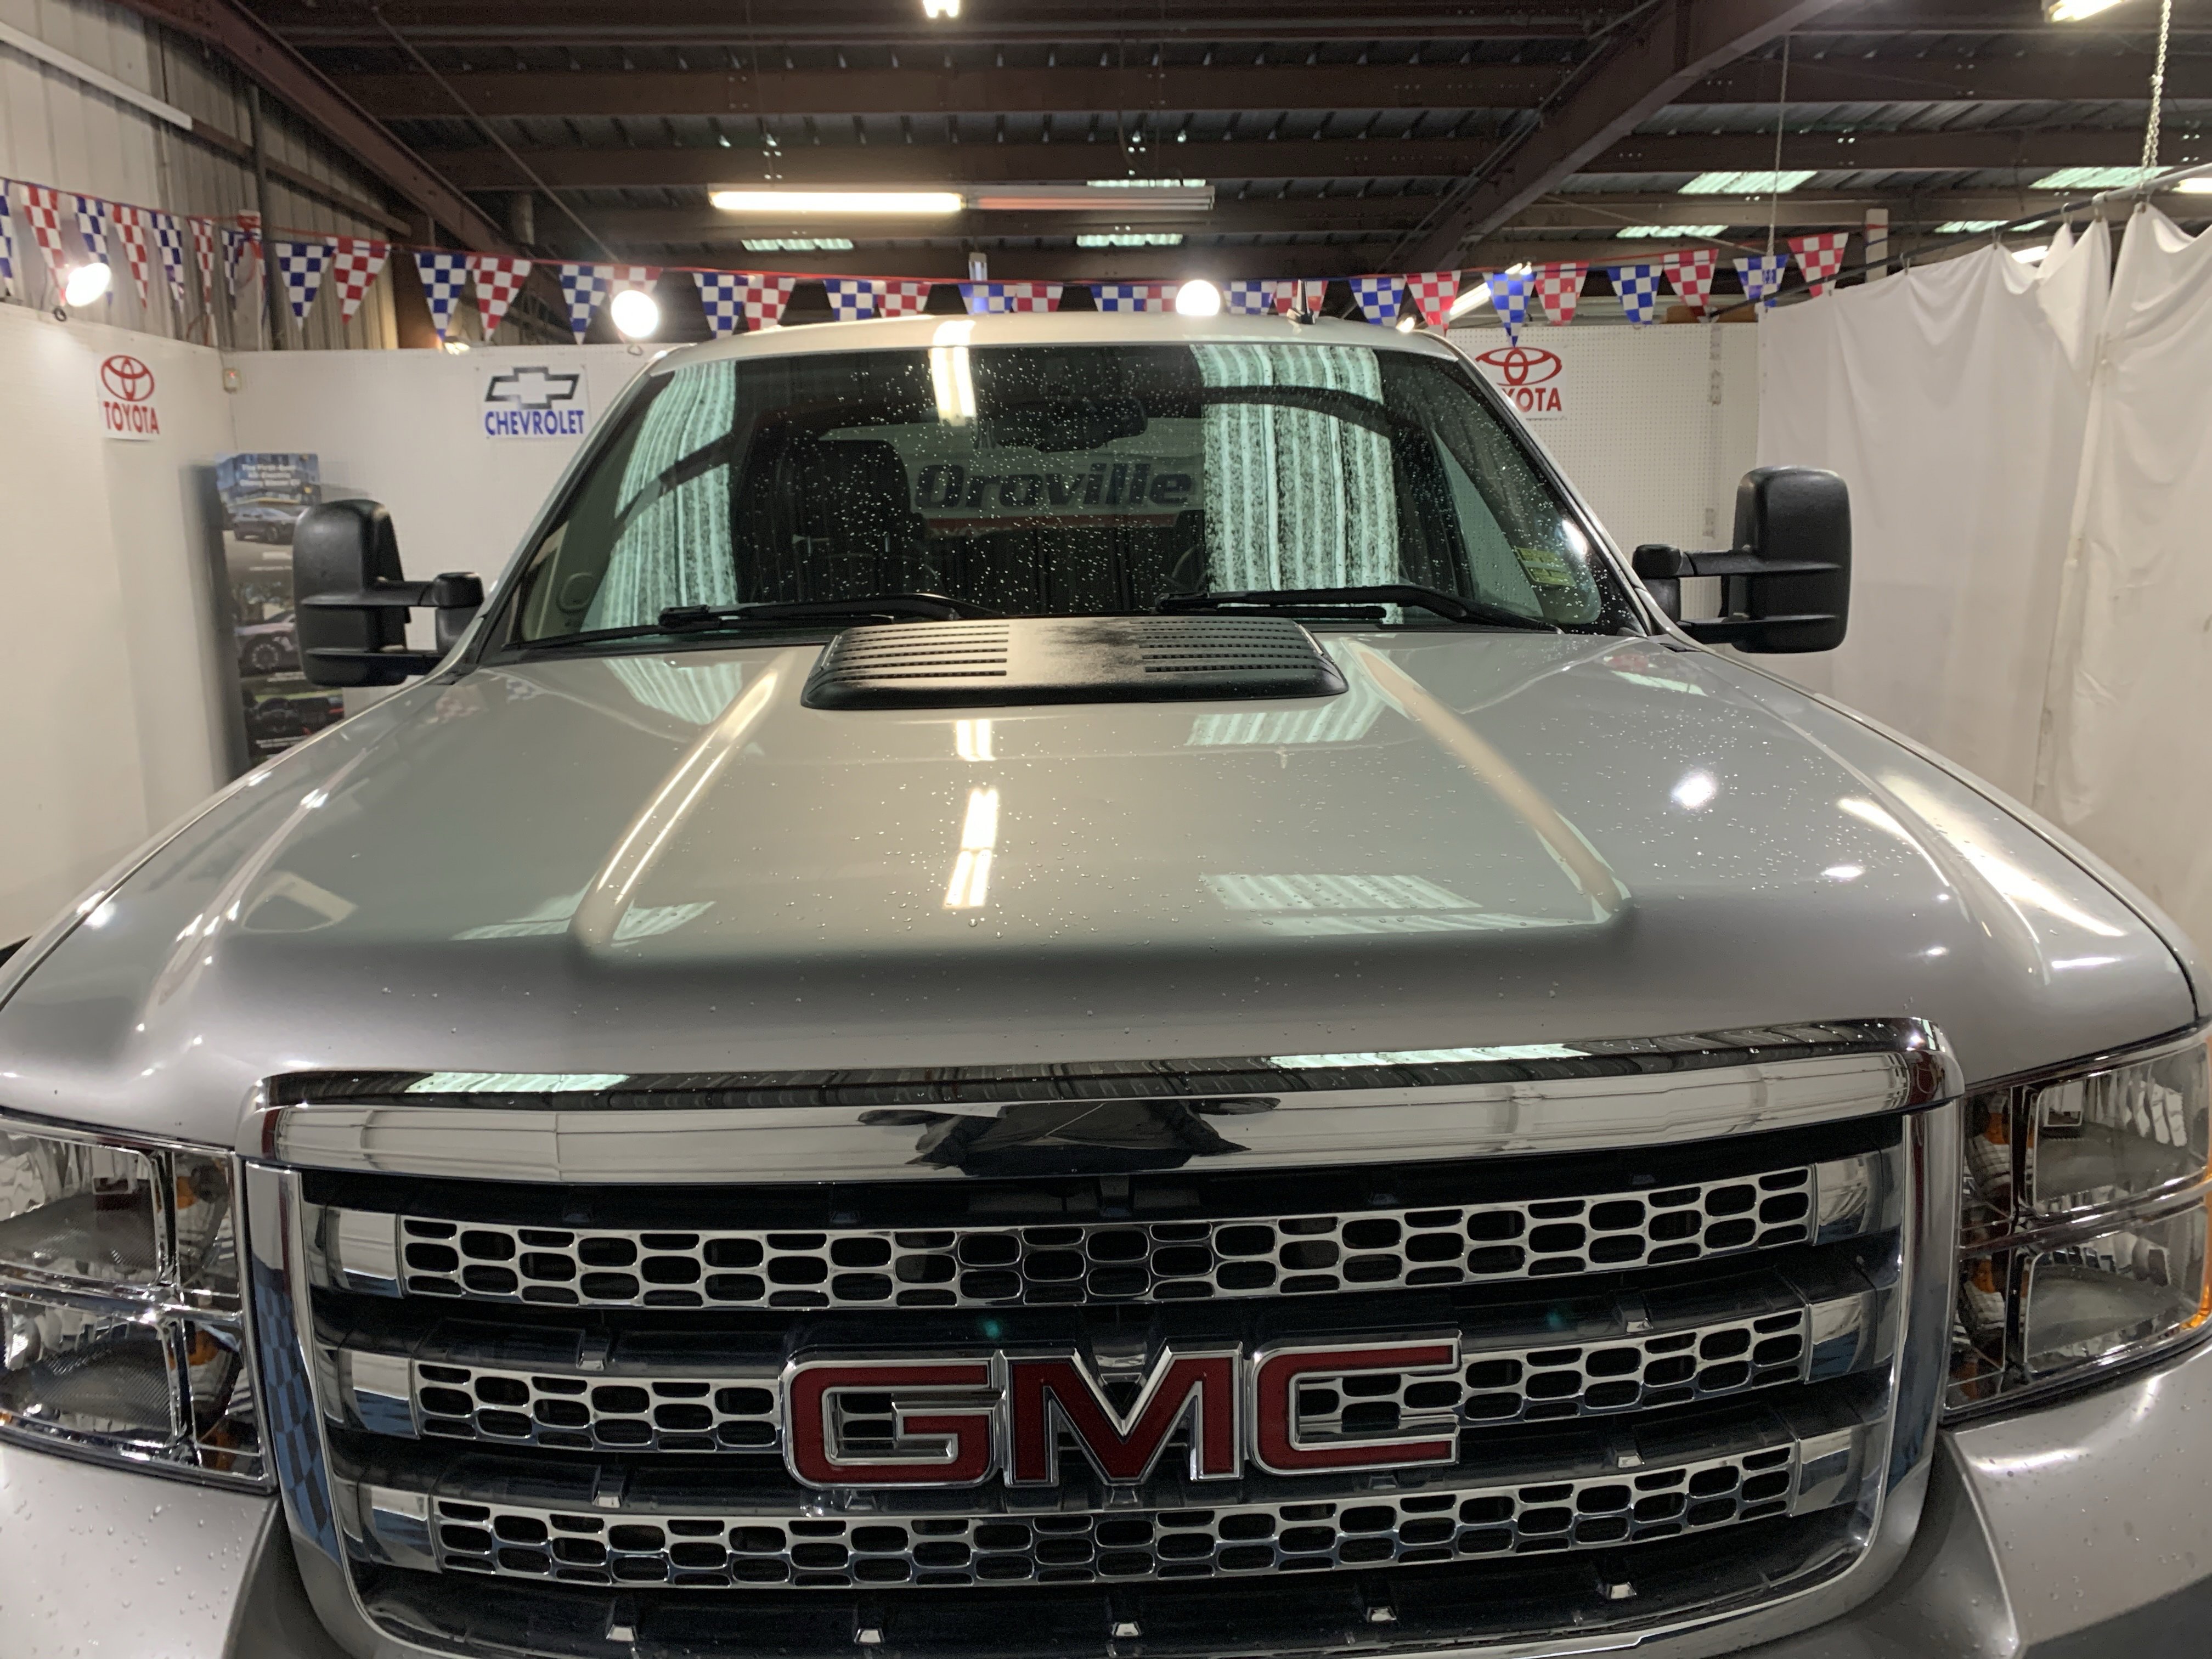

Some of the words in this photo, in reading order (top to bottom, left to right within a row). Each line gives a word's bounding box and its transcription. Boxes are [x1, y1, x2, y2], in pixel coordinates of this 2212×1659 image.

[104, 400, 160, 435] TOYOTA
[484, 410, 584, 436] CHEVROLET
[915, 463, 1192, 508] Oroville
[780, 1336, 1460, 1488] GMC
